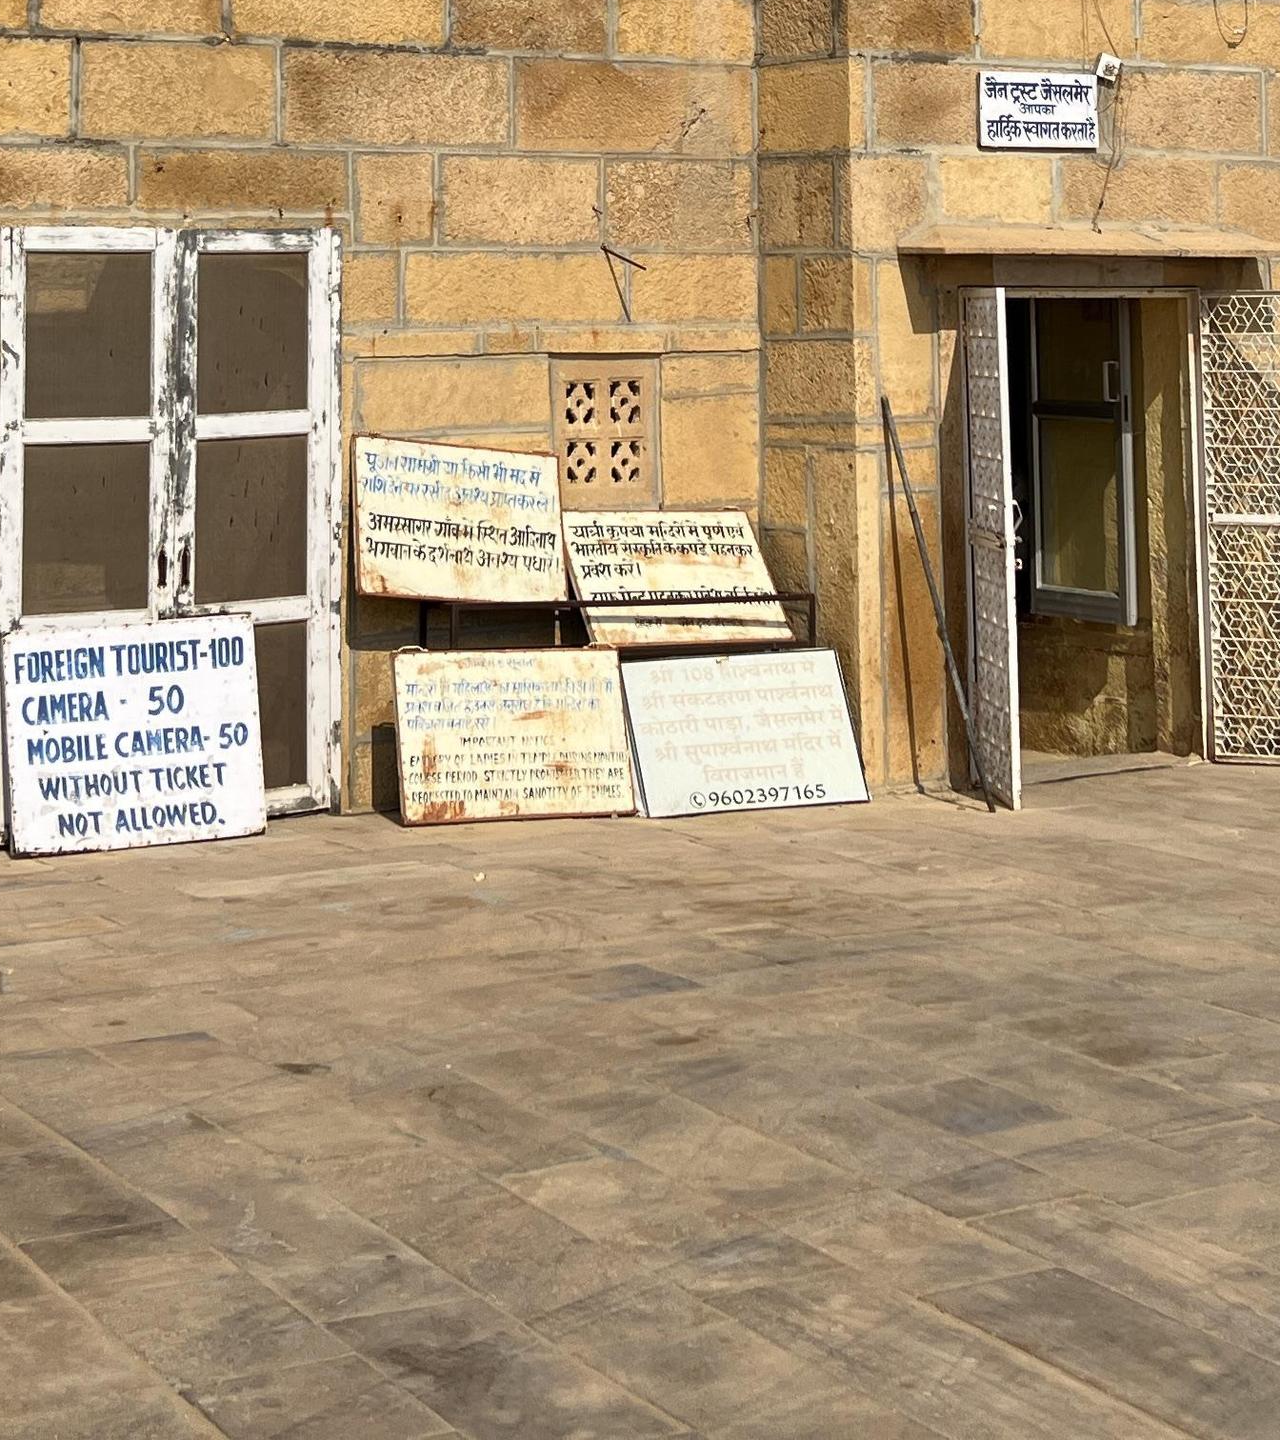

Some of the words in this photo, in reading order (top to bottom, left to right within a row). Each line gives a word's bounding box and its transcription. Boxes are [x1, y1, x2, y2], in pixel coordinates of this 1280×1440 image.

[985, 76, 1009, 100] जैन
[1010, 82, 1039, 104] ट्रस्ट
[1040, 78, 1092, 105] जैसलमेर
[1019, 103, 1056, 115] आपका
[987, 115, 1022, 142] हार्दिक
[1022, 121, 1060, 141] स्वागत
[368, 512, 432, 537] अमरसागर
[365, 537, 412, 560] भगवान
[13, 646, 106, 684] FOREIGN
[684, 665, 714, 683] 108
[22, 690, 110, 726] CAMERA
[148, 684, 185, 716] 50
[26, 734, 109, 765] MOBILE
[219, 722, 249, 750] 50
[38, 769, 142, 802] WITHOUT
[149, 762, 227, 793] TICKET
[708, 784, 827, 807] 9602397165
[57, 810, 104, 838] NOT
[115, 800, 226, 834] ALLOWED.
